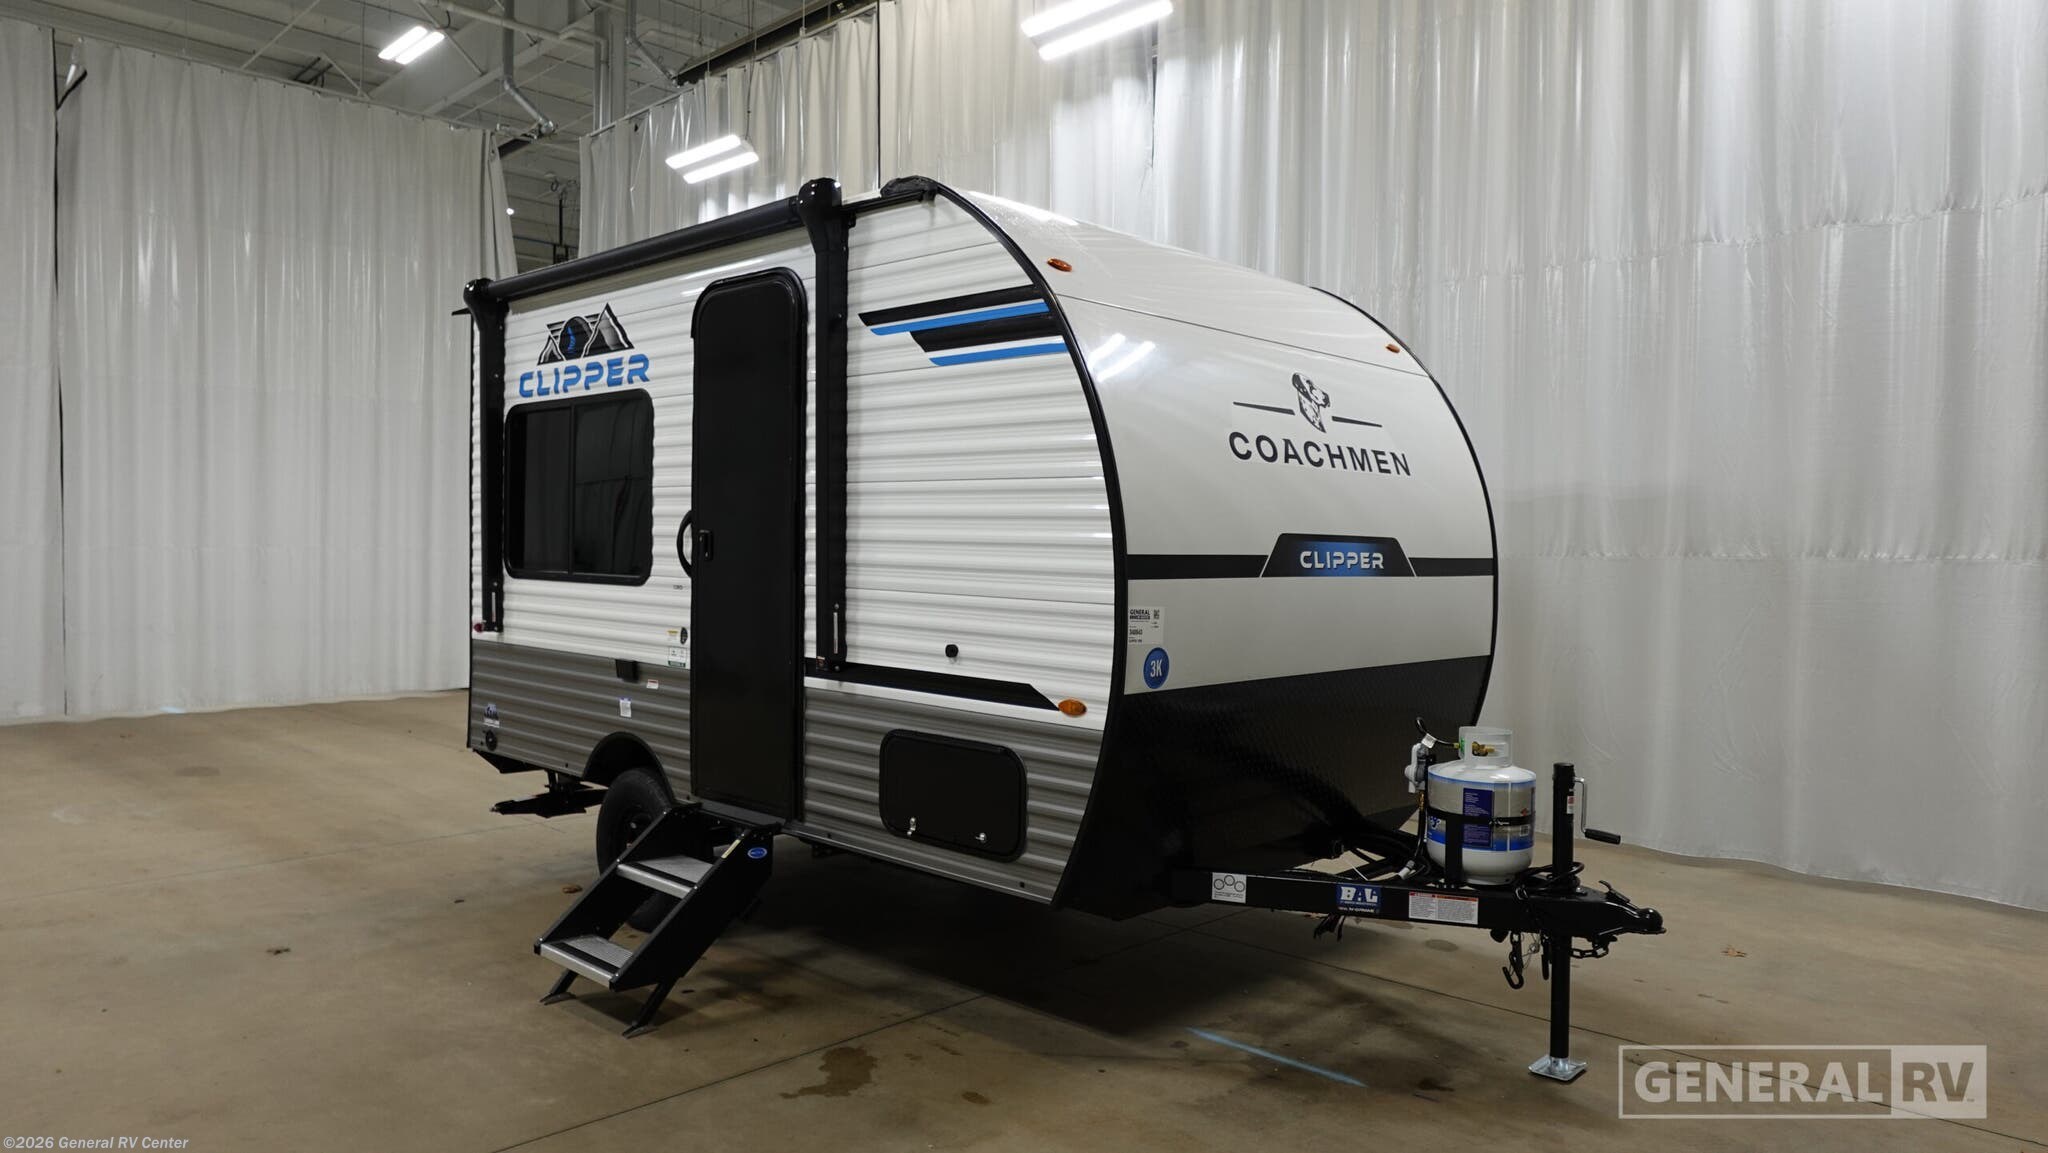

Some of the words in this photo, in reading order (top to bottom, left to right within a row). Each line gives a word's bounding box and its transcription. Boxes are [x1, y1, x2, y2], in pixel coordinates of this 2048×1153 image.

[519, 354, 650, 398] CLIPPER
[1229, 431, 1411, 476] COACHMEN
[1300, 550, 1385, 570] CLIPPER
[1150, 659, 1163, 678] 3K
[1340, 886, 1379, 903] BAL
